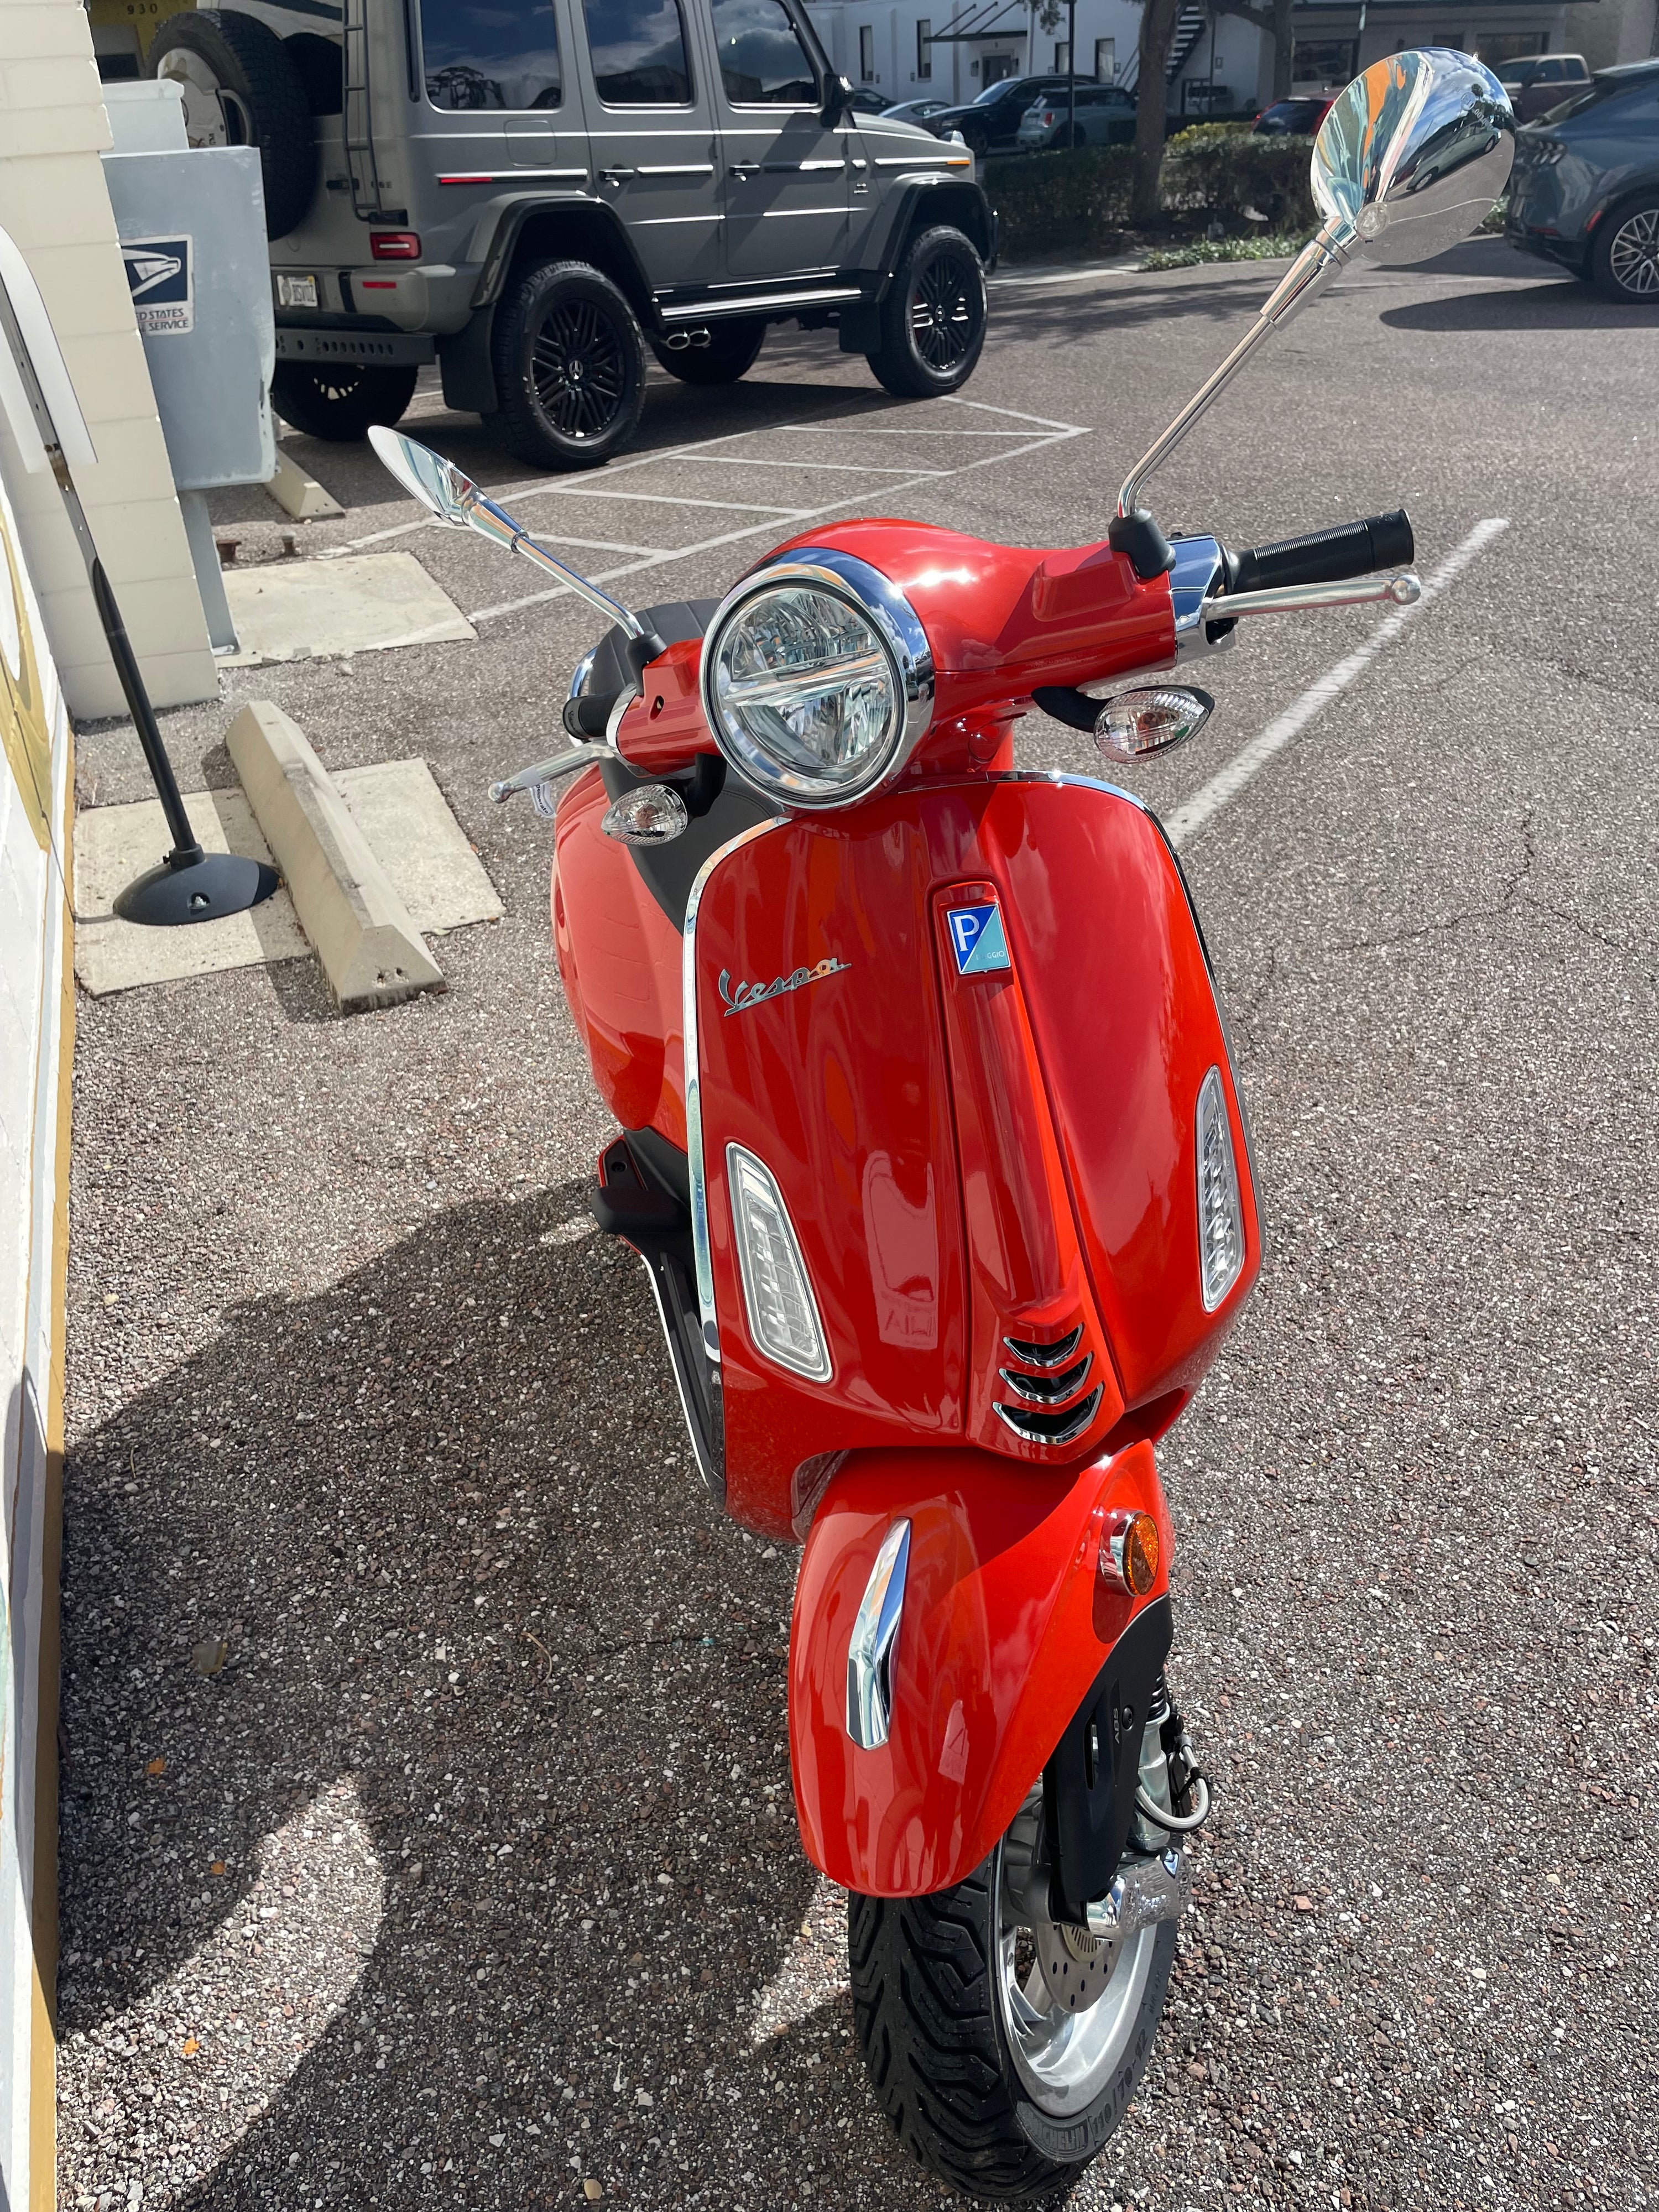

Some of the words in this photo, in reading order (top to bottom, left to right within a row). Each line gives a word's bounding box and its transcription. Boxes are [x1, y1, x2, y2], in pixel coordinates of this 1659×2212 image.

[127, 3, 158, 15] 930
[149, 308, 184, 320] STATES
[149, 320, 189, 331] SERVICE
[952, 914, 980, 952] P
[976, 950, 1005, 961] GGIO
[718, 957, 852, 1018] Vespa
[1027, 2115, 1084, 2150] ICHELIN
